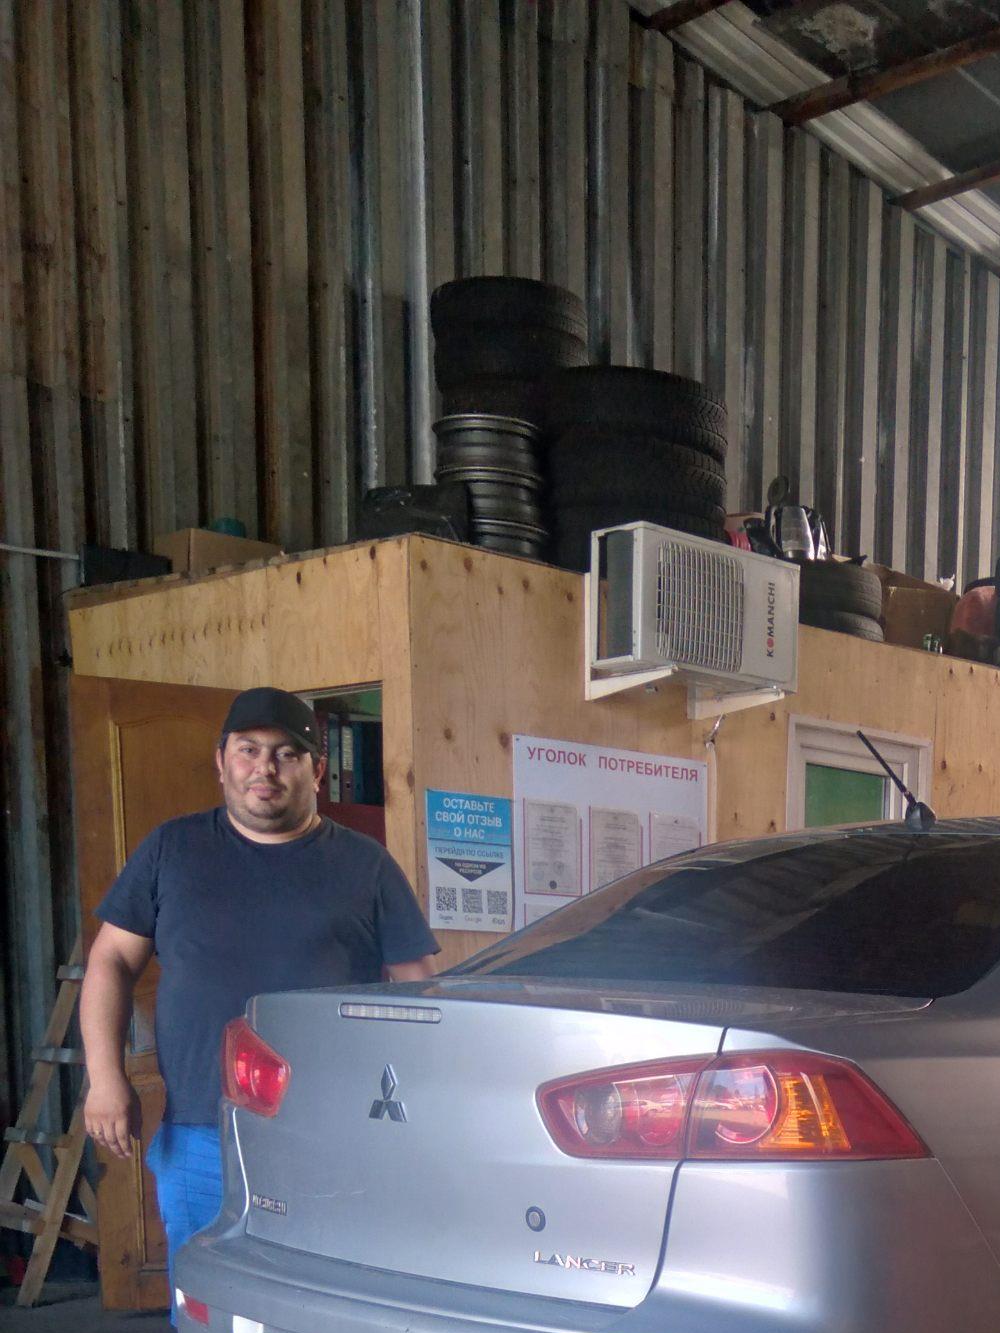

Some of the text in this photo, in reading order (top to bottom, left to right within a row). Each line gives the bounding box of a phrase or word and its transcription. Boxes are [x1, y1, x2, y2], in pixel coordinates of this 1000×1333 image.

[526, 746, 699, 782] УГОЛОК ПОТРЕБИТЕЛЯ
[443, 797, 495, 813] ОСТАВЬТЕ
[435, 810, 503, 828] СВОЙ ОТЗЫВ
[453, 826, 485, 840] О НАС
[534, 1251, 636, 1276] LANCER
